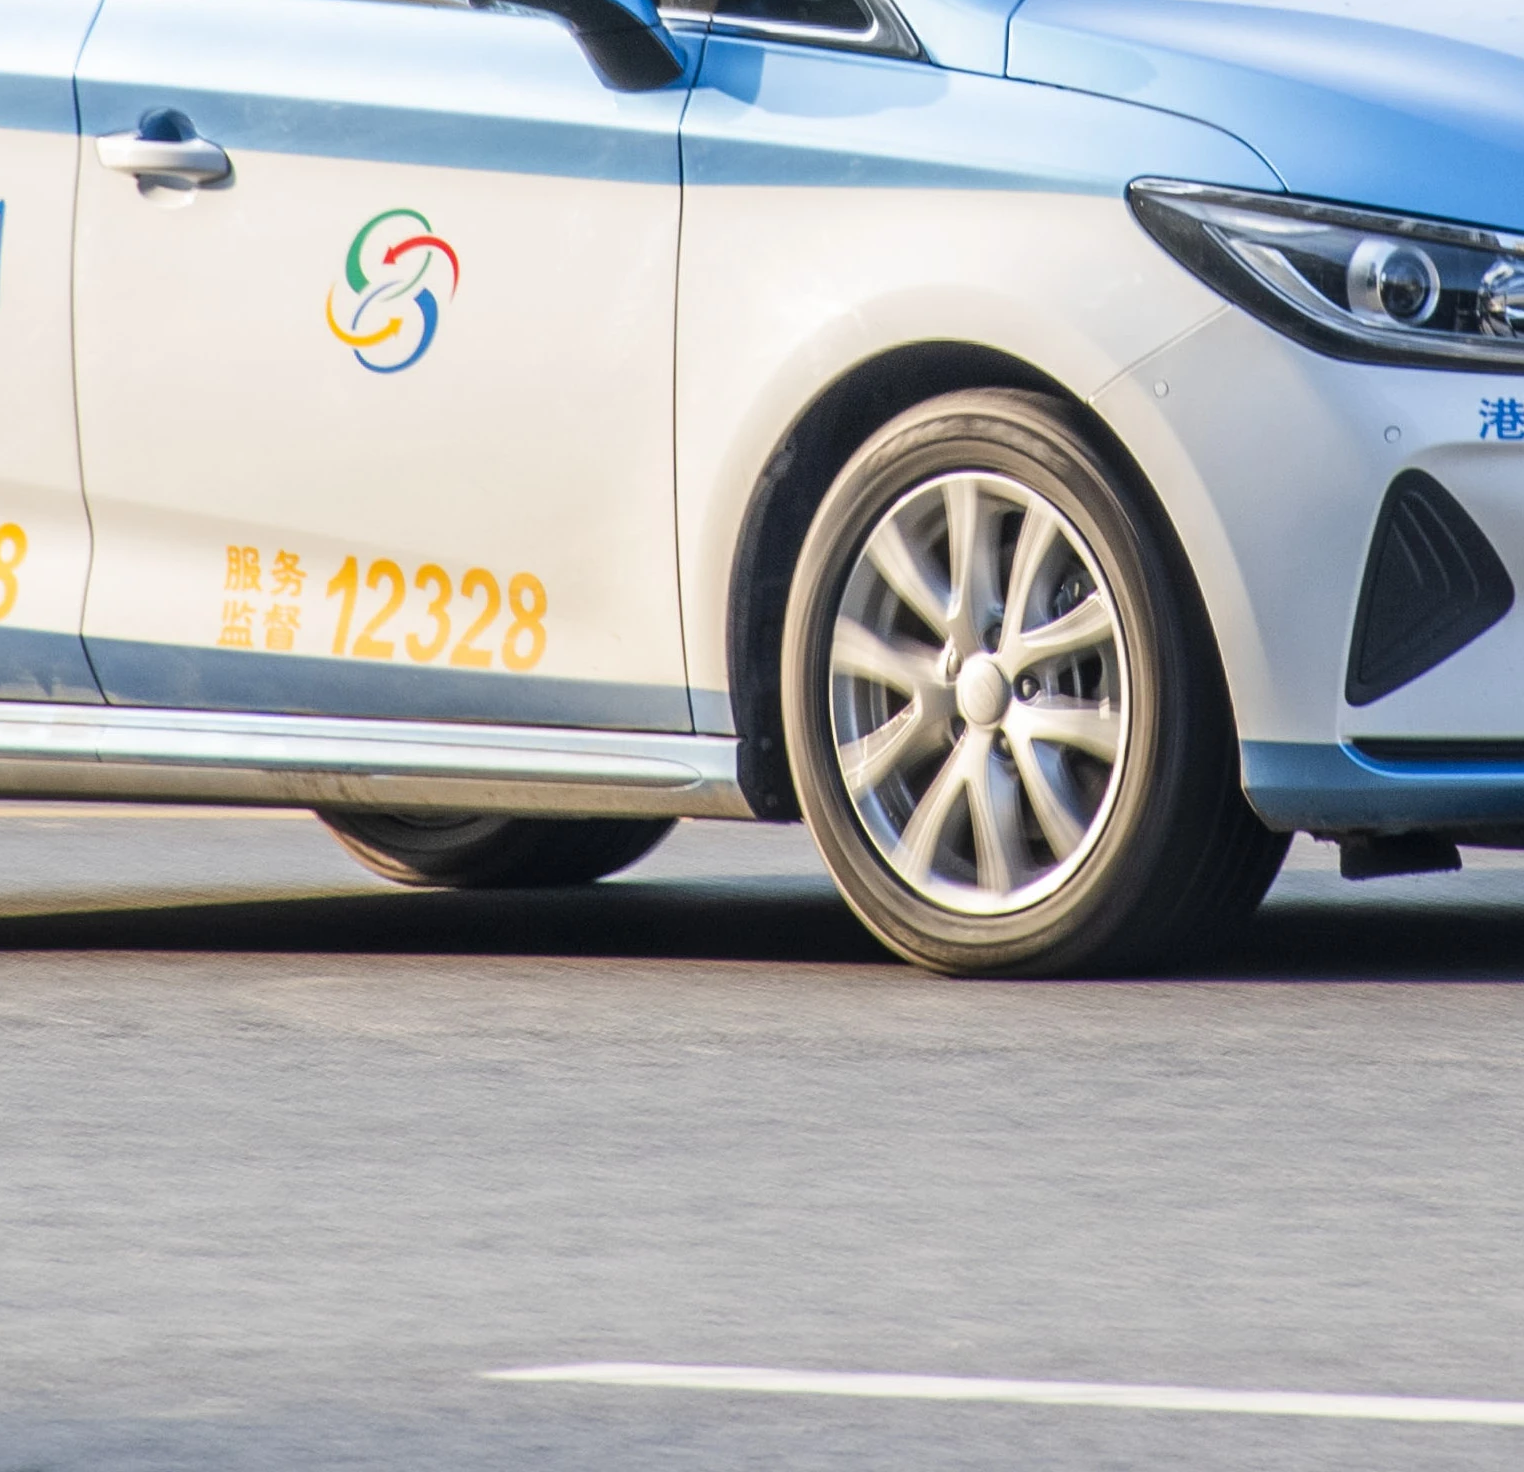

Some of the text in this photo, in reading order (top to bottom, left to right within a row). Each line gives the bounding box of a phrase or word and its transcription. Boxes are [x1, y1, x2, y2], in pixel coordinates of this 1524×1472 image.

[223, 544, 309, 597] 服务
[216, 598, 303, 652] 监督
[325, 554, 549, 673] 12328
